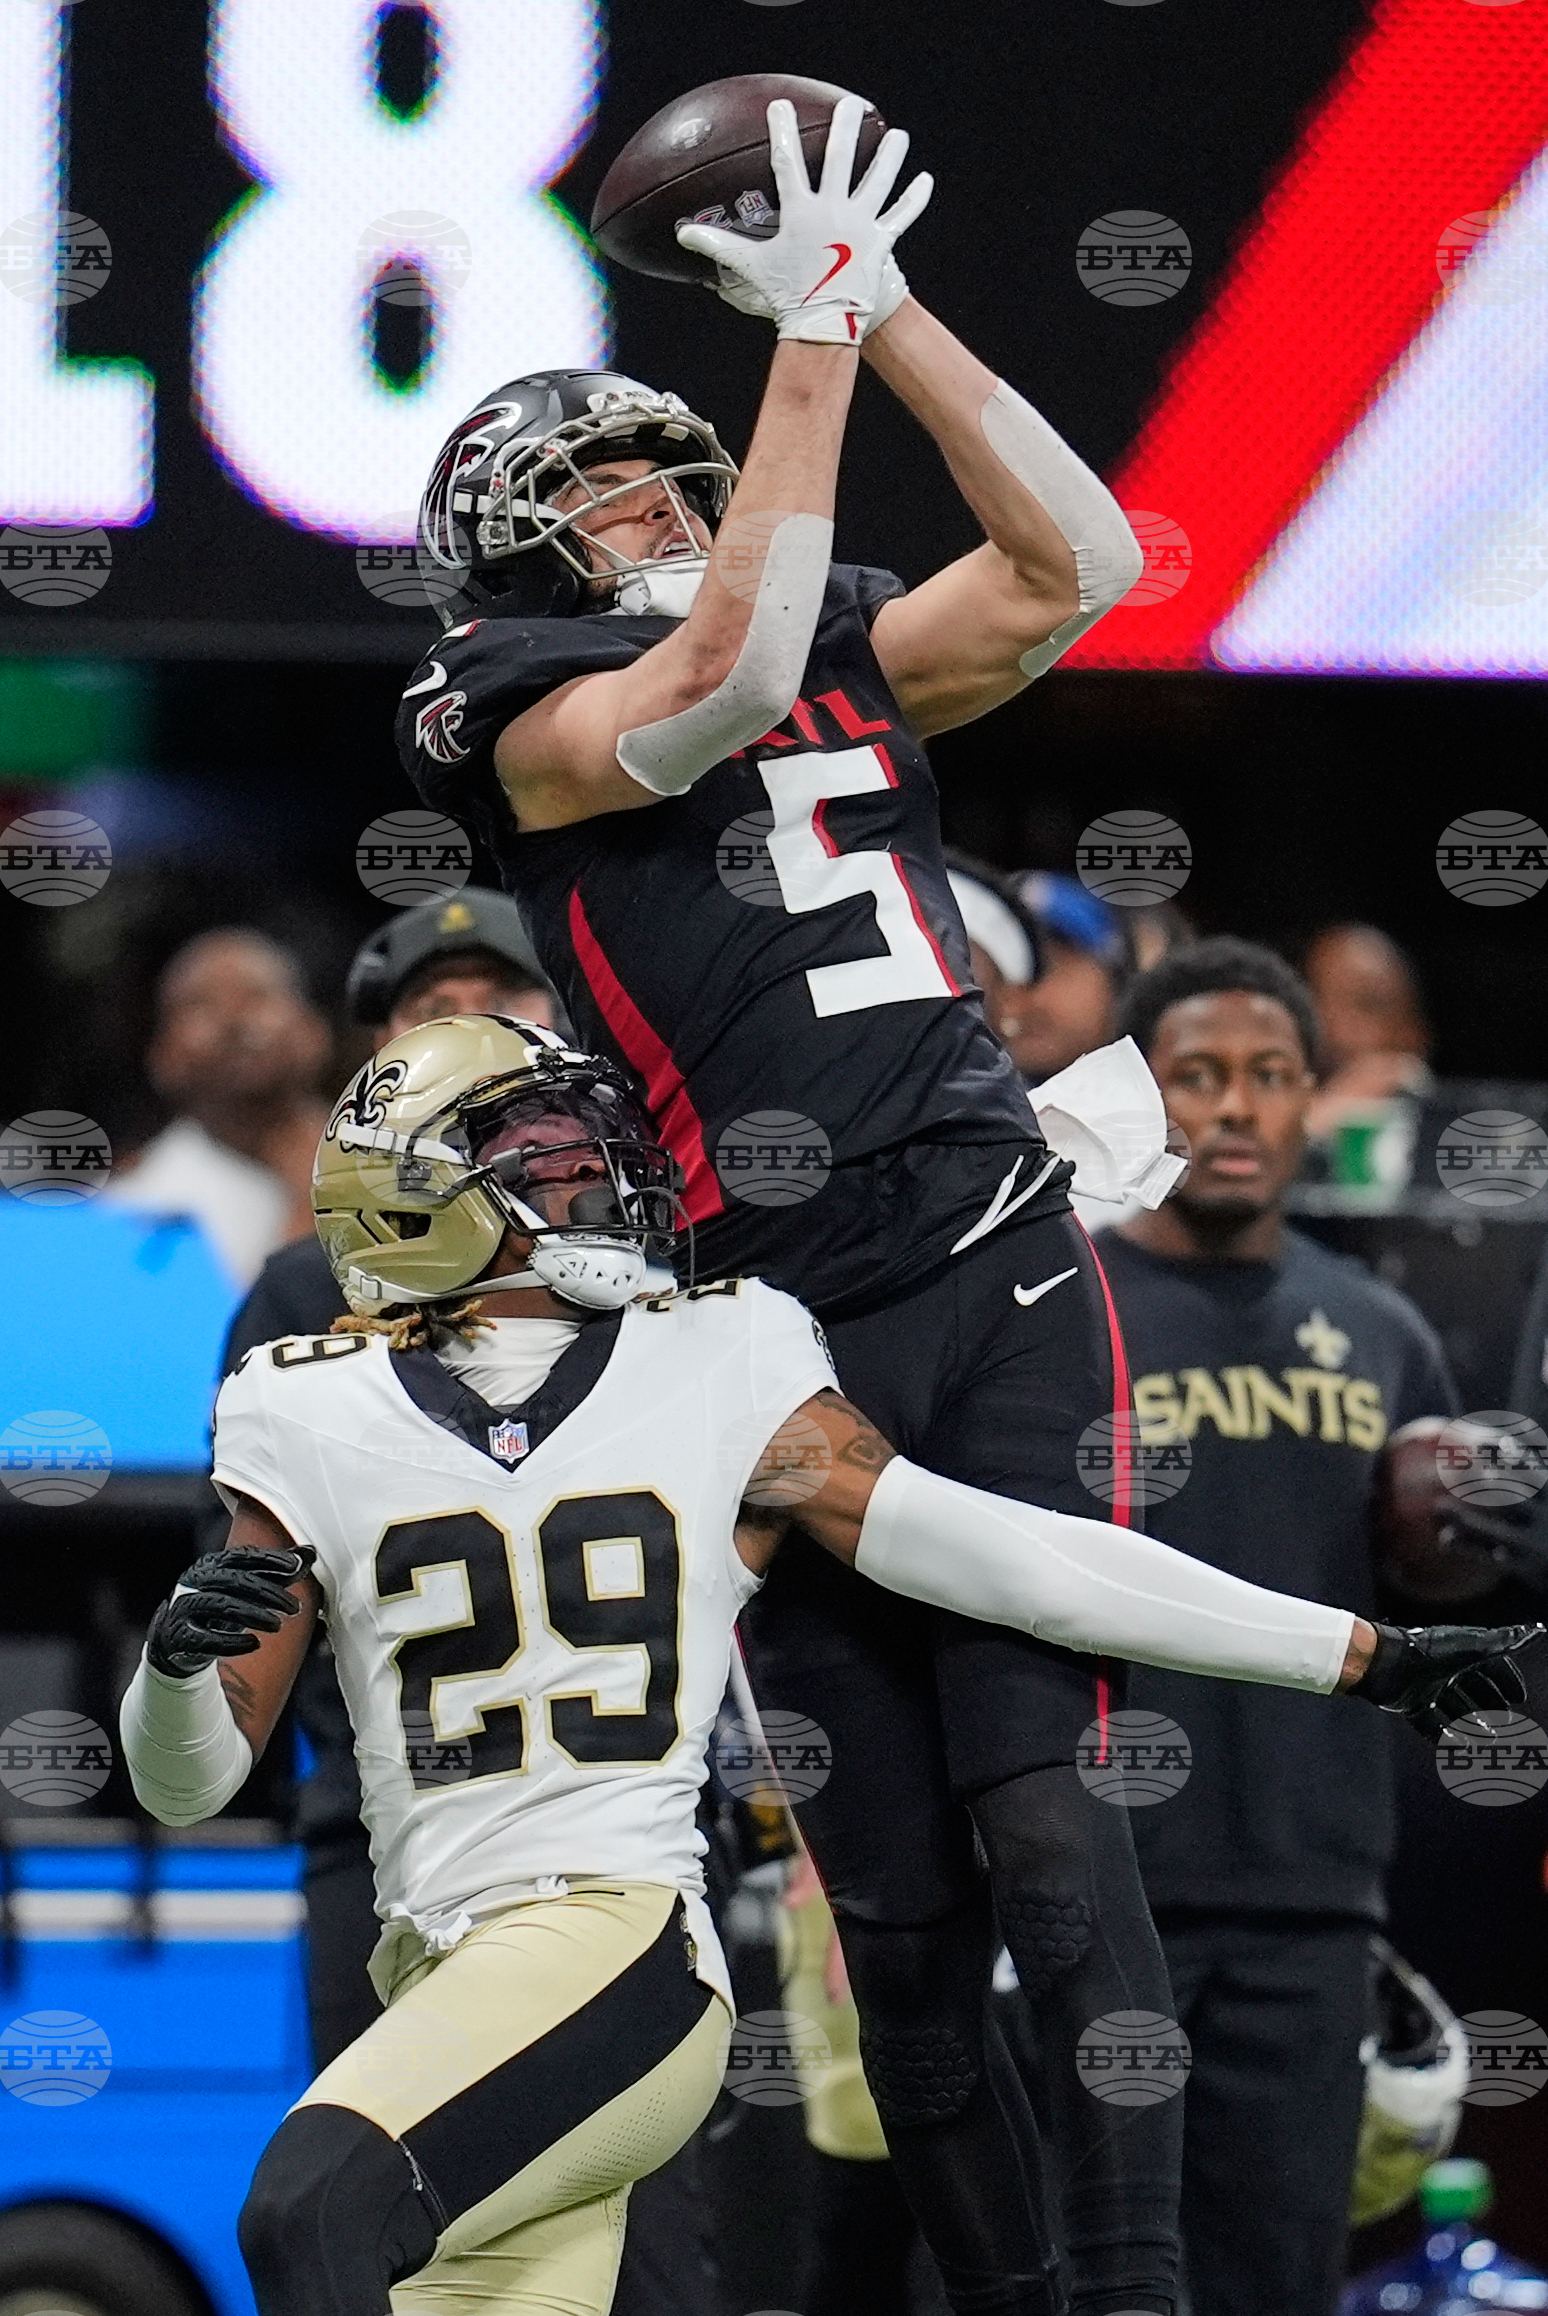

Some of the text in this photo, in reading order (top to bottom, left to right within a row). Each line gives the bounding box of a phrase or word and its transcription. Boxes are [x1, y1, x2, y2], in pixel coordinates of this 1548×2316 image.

[740, 193, 764, 214] NFL
[757, 742, 962, 1018] 5
[497, 1437, 522, 1454] NFL
[1133, 1364, 1388, 1452] SAINTS
[370, 1485, 684, 1794] 29
